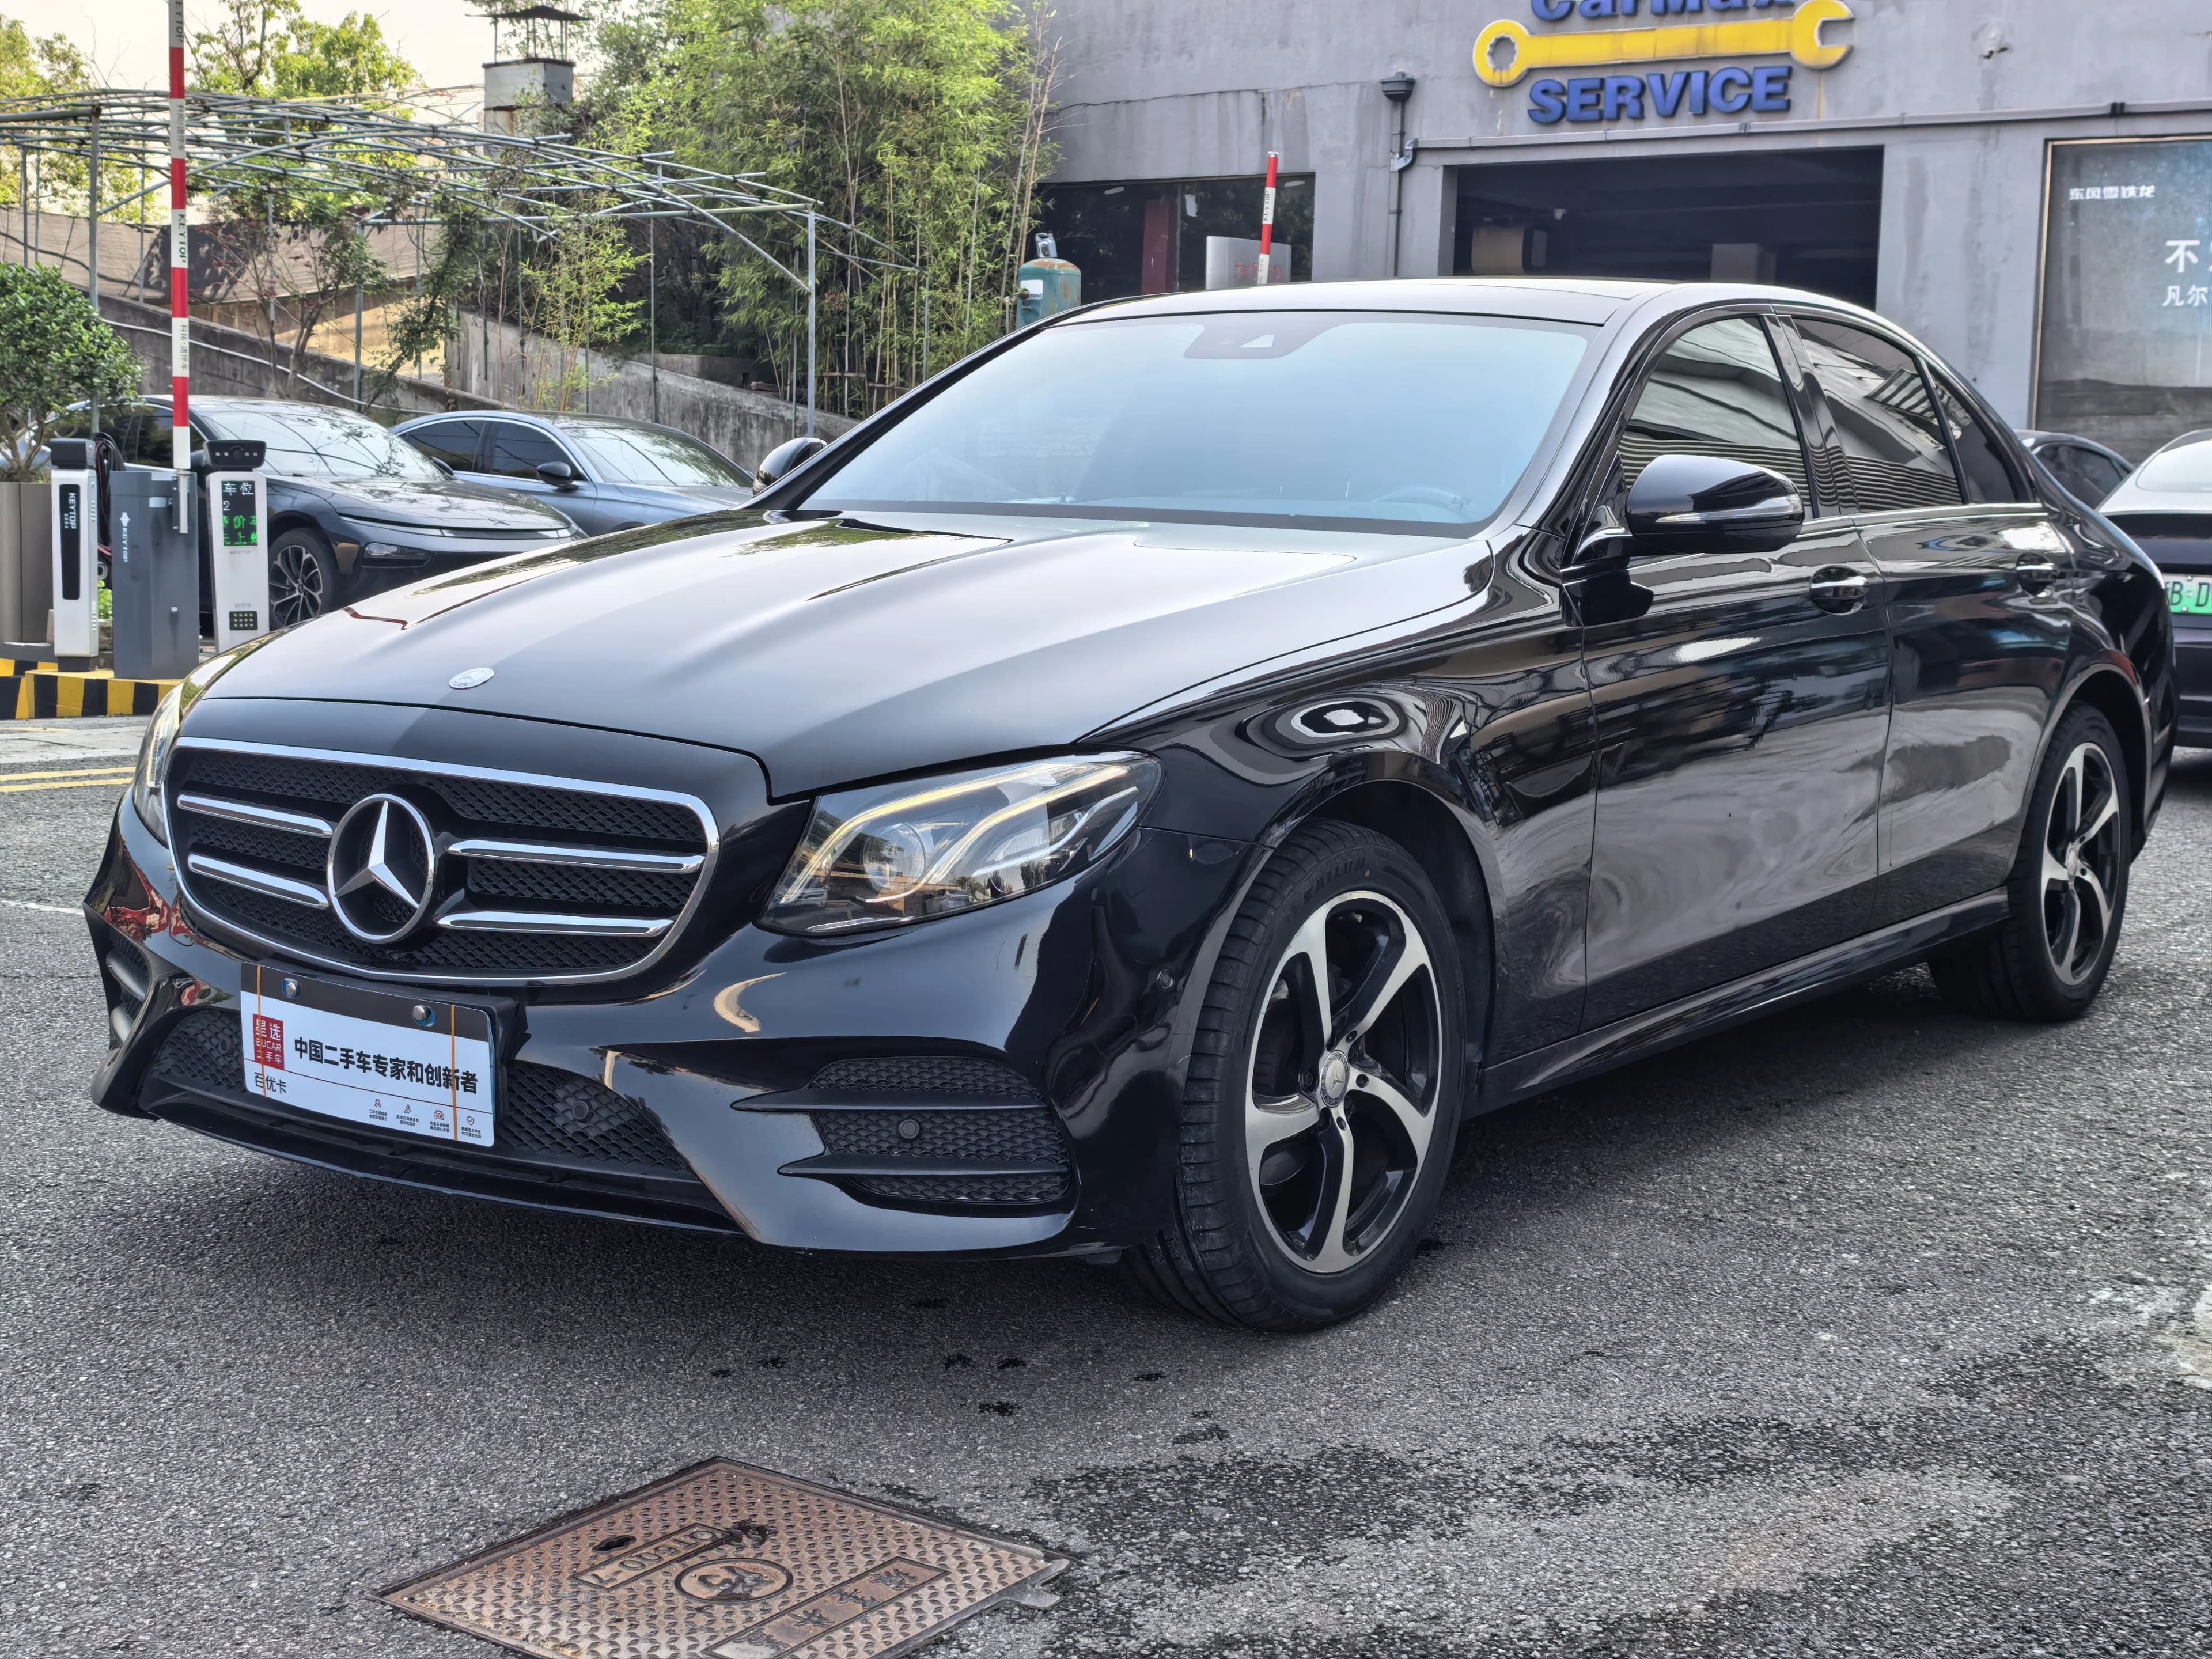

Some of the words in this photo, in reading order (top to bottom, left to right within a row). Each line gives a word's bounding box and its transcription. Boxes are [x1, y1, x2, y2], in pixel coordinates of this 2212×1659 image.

[176, 0, 184, 43] EYTOP
[1528, 66, 1792, 124] SERVICE
[2165, 240, 2212, 273] 不
[69, 493, 77, 529] KEYTOP
[224, 501, 230, 511] 2
[2165, 581, 2211, 607] BD
[256, 1019, 281, 1041] 星选
[257, 1050, 282, 1064] 二手车
[294, 1037, 478, 1094] 中国二手车专家和创新者
[254, 1072, 287, 1094] 百优卡
